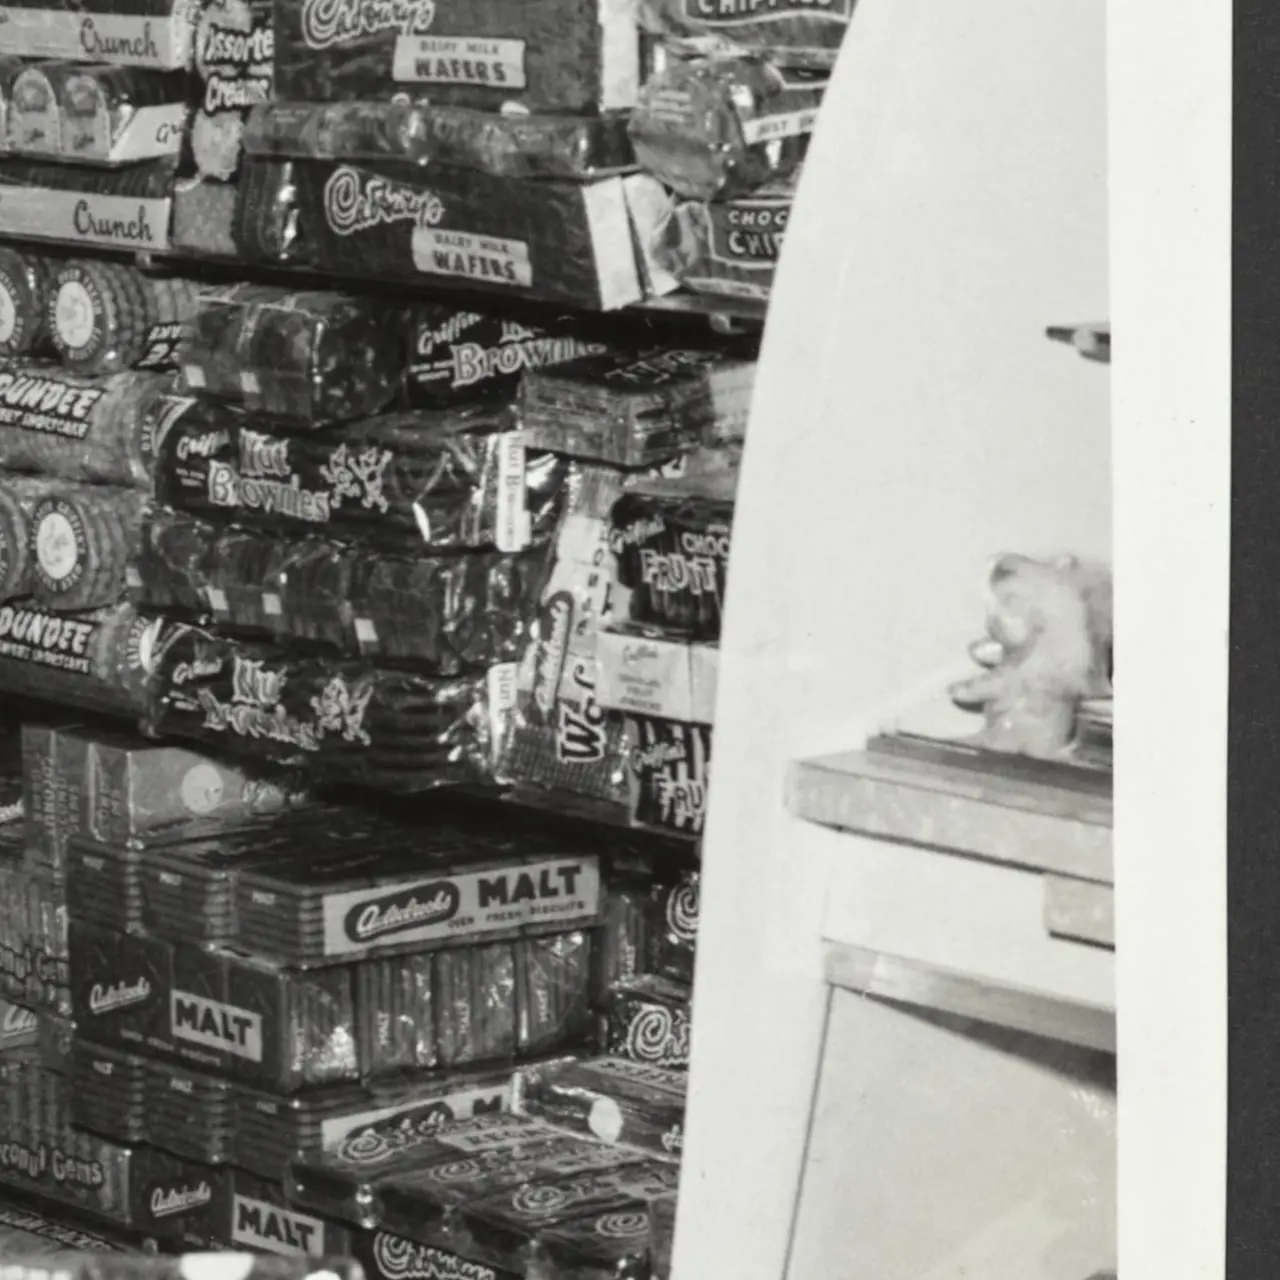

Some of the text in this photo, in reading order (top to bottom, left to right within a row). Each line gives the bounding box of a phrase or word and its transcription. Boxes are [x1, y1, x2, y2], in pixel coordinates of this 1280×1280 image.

[79, 18, 160, 58] Crunch
[206, 24, 274, 62] Assorte
[414, 58, 507, 83] WAFERS
[72, 200, 154, 243] Crunch
[433, 252, 517, 282] WAFERS
[208, 460, 331, 521] Brownies
[477, 864, 583, 909] MALT
[175, 996, 254, 1046] MALT
[52, 1149, 105, 1186] Gems
[239, 1204, 315, 1245] MALT
